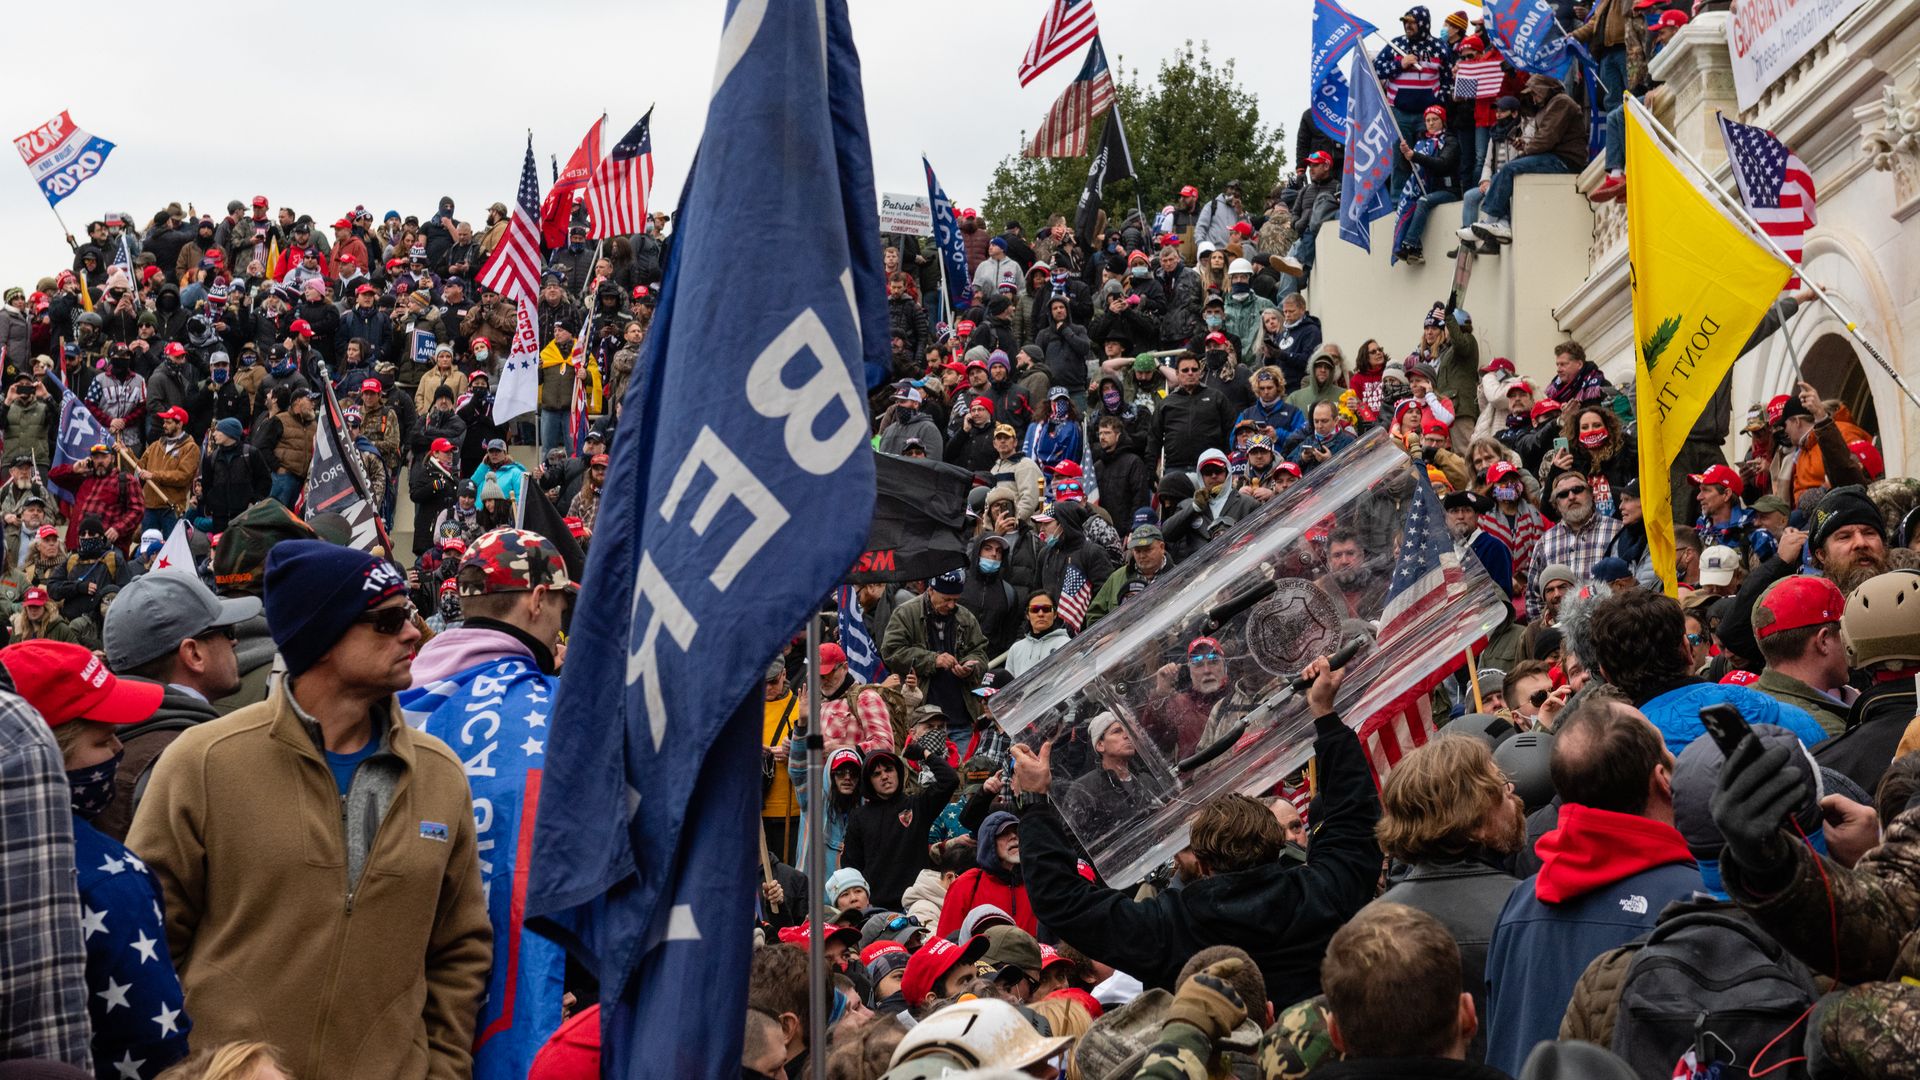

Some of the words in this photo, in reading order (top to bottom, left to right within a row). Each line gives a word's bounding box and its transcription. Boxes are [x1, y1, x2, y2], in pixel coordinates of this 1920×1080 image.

[46, 150, 102, 197] 2020
[882, 199, 915, 211] Patriot
[1280, 581, 1304, 589] UNITED
[869, 949, 884, 960] MAKE
